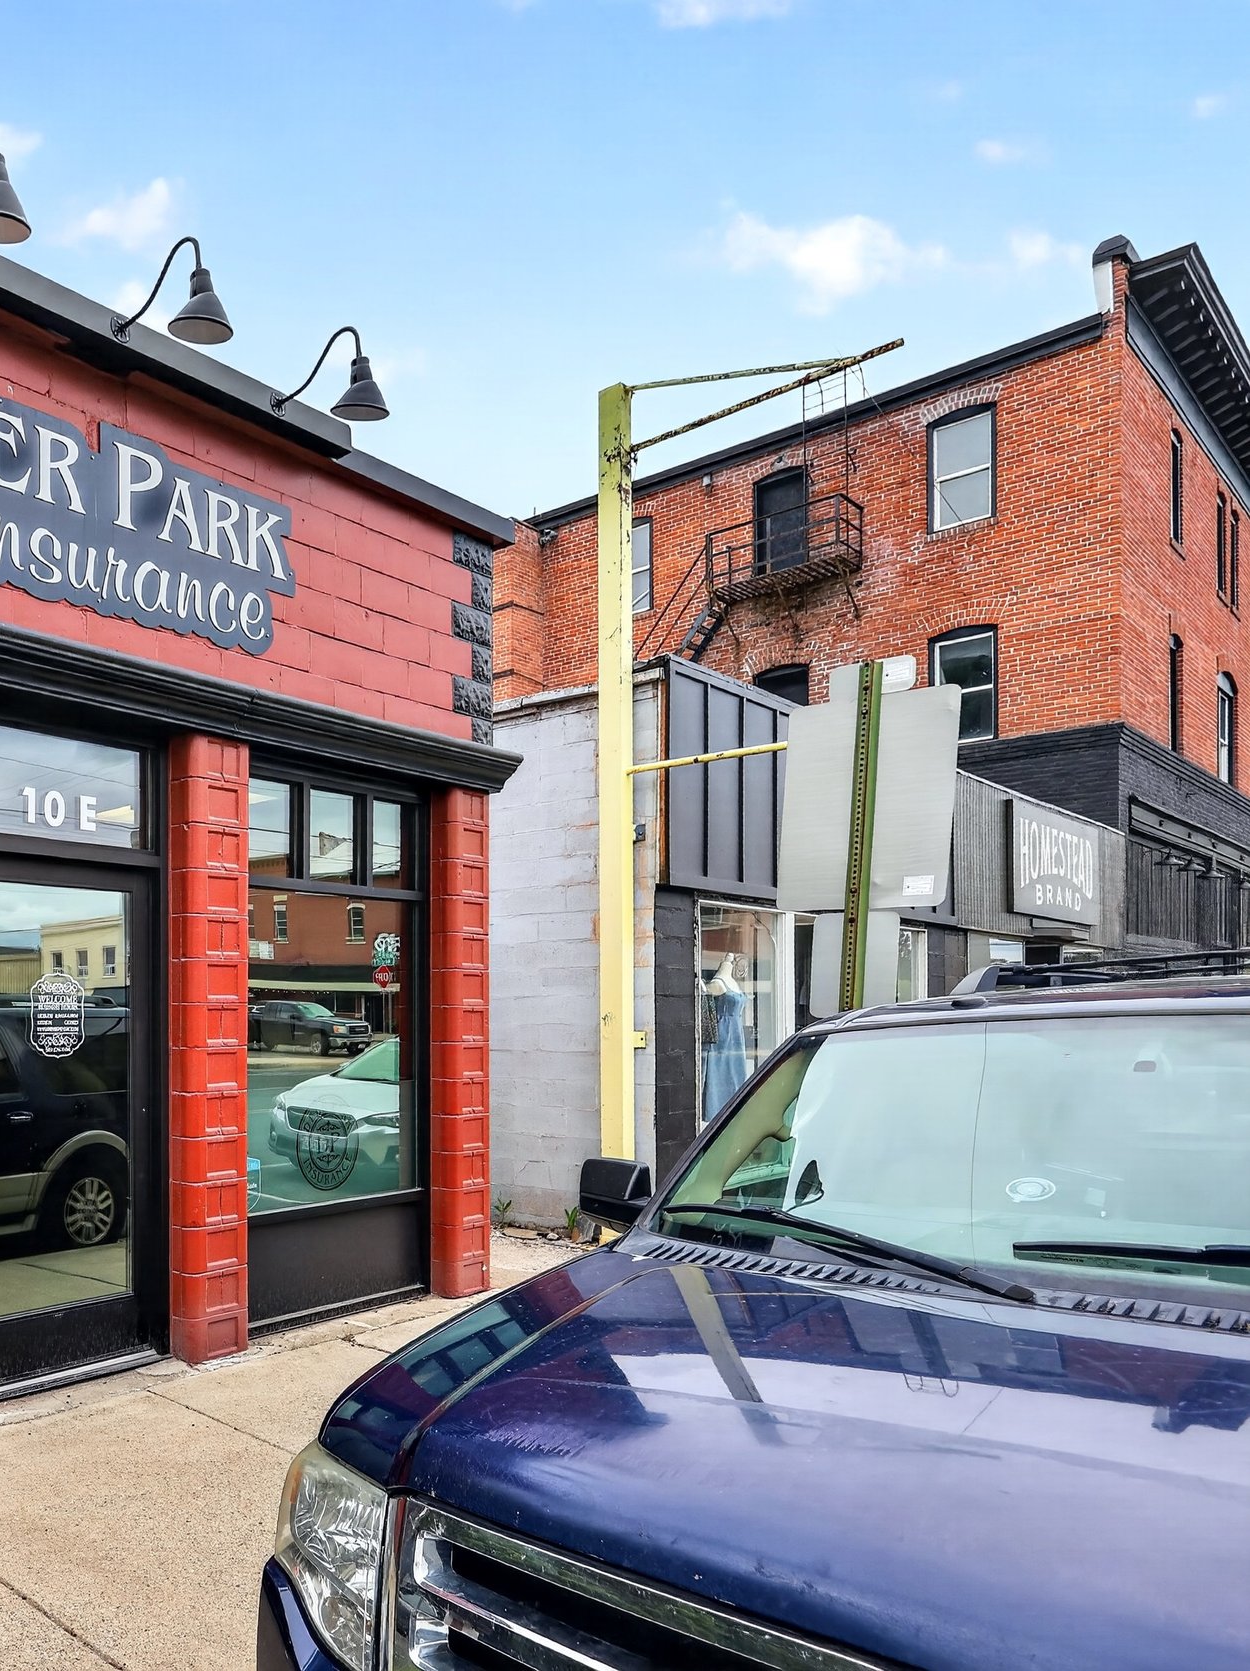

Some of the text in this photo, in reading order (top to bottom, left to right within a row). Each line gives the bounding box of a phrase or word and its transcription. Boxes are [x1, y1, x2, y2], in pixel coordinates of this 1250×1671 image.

[112, 441, 288, 580] PARK
[22, 787, 96, 831] 10 E
[1020, 818, 1093, 899] HOMESTEAD
[1035, 884, 1082, 911] BRAND
